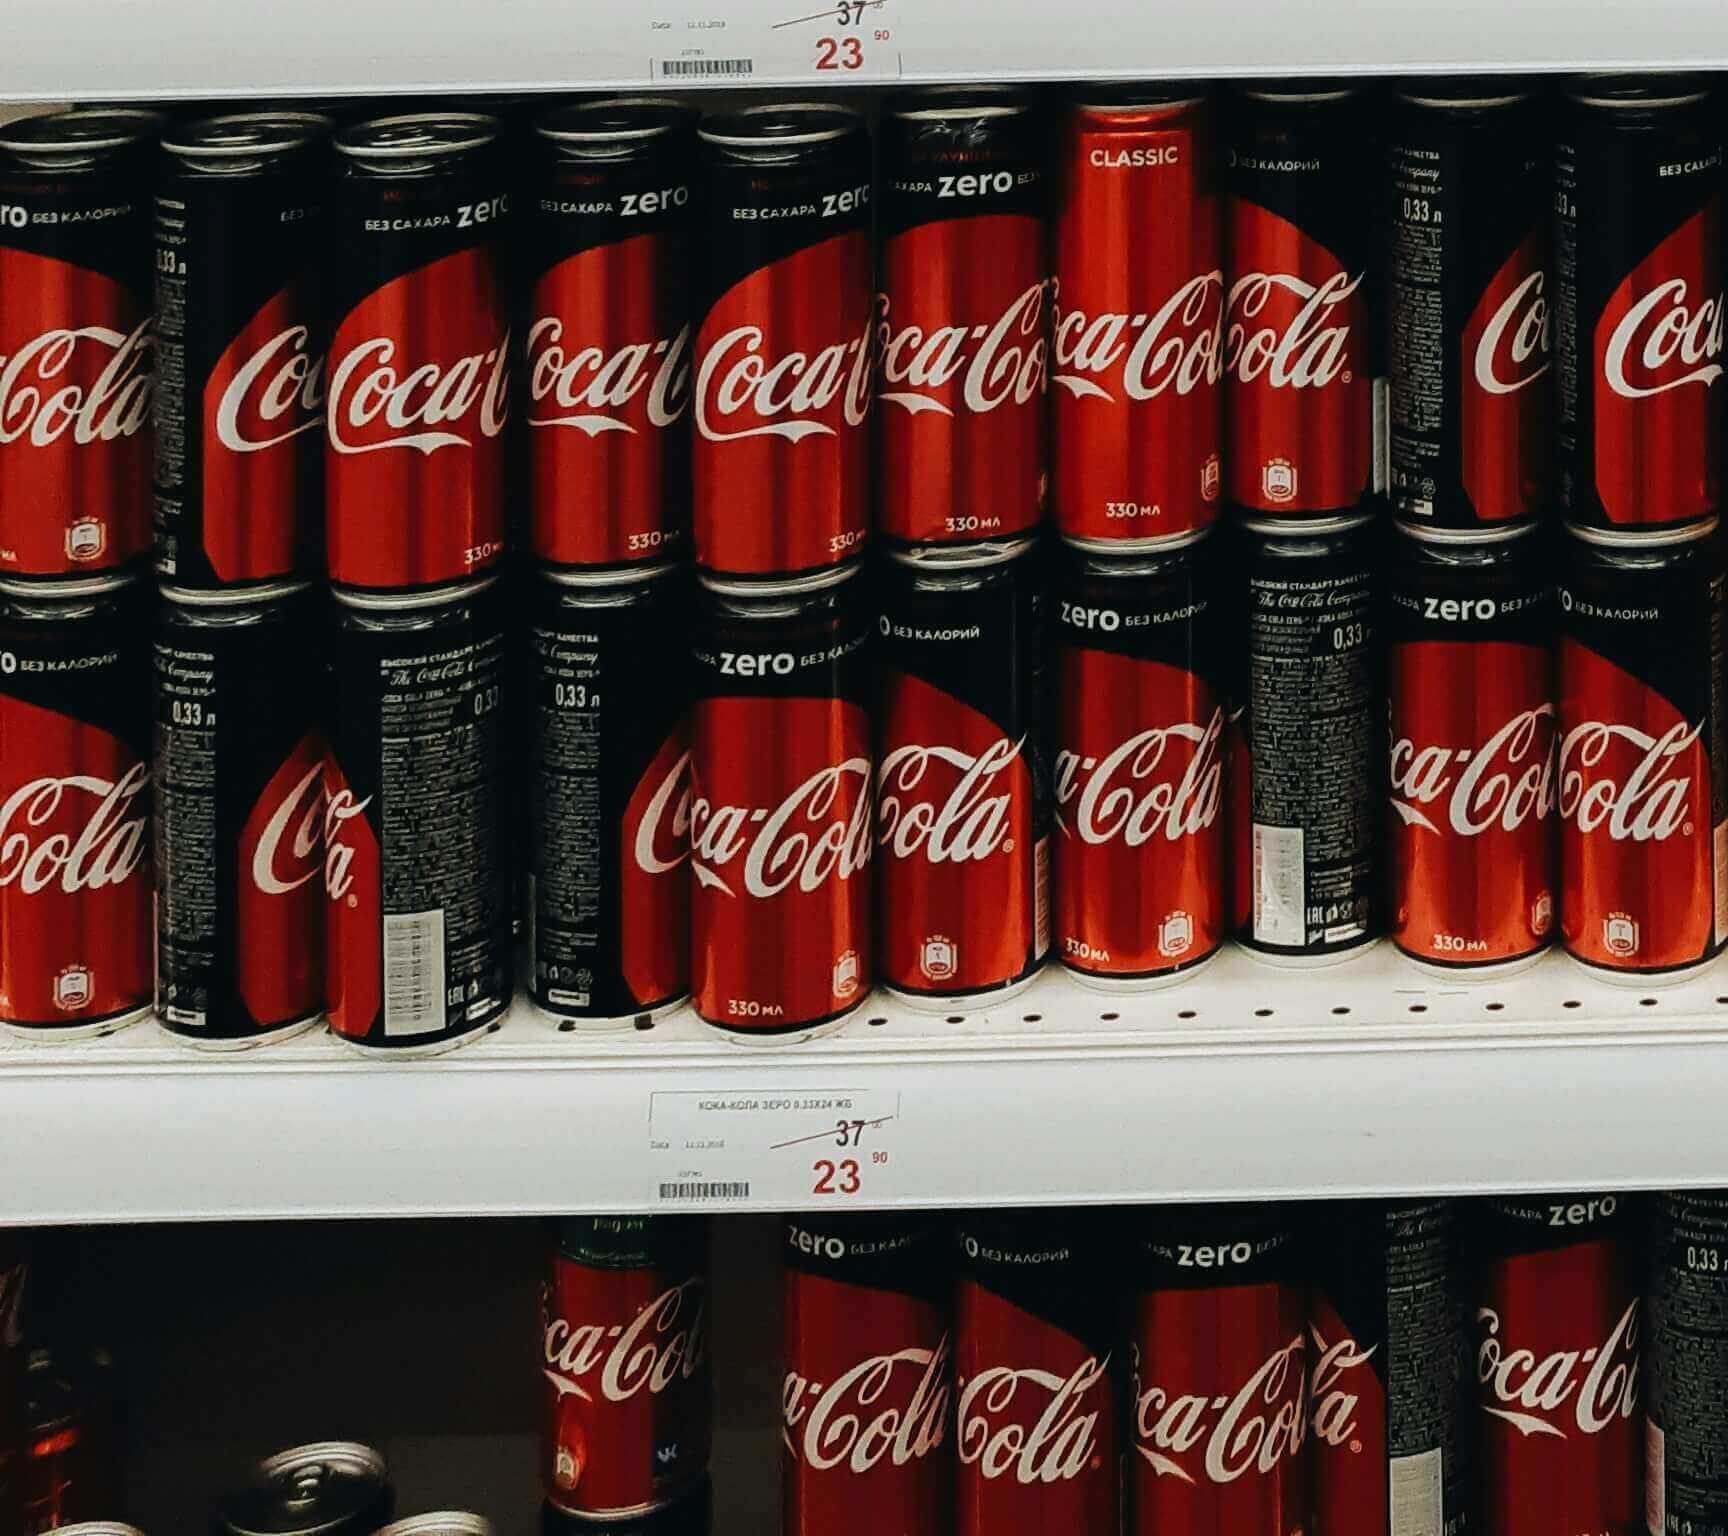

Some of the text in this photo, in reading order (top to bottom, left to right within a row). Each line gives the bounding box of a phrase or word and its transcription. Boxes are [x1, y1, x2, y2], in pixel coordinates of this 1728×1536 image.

[837, 1, 866, 25] 37
[816, 30, 889, 70] 23 90
[1091, 147, 1178, 168] CLASSIC
[937, 169, 1013, 199] zero
[621, 186, 688, 217] zero
[365, 215, 450, 231] БЕЗ САХАРА
[1106, 502, 1140, 518] 330
[1061, 602, 1119, 631] zero
[1424, 594, 1496, 622] zero
[720, 649, 794, 678] zero
[1433, 935, 1466, 951] 330
[728, 999, 759, 1016] 330
[835, 1120, 864, 1146] 37
[813, 1152, 888, 1194] 23 90
[1549, 1196, 1616, 1227] zero
[789, 1225, 845, 1260] zero
[1687, 1246, 1720, 1271] 0,33
